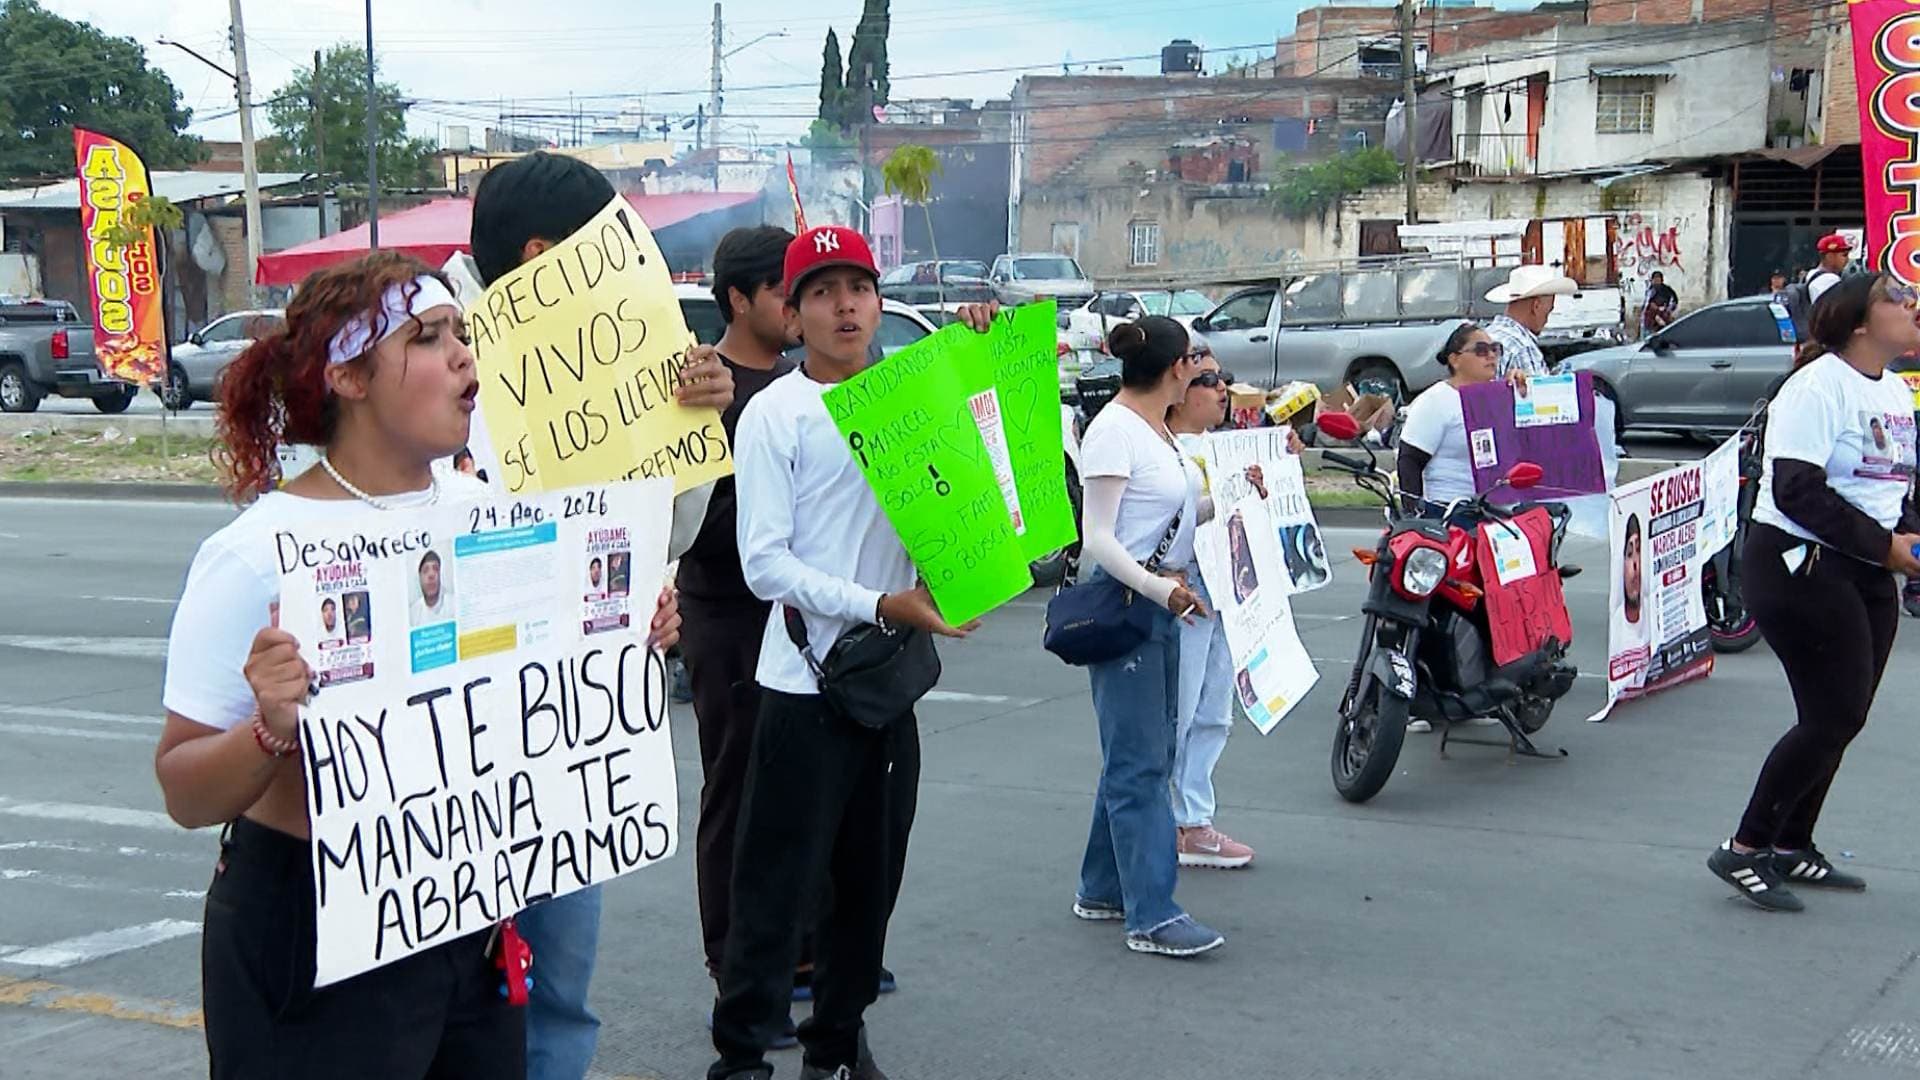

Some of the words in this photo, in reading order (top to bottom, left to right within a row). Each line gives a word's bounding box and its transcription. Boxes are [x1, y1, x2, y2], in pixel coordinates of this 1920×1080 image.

[814, 229, 840, 253] NY
[499, 298, 647, 408] VIVOS
[504, 433, 536, 493] SE
[549, 399, 609, 461] LOS
[1650, 480, 1666, 517] SE
[1666, 467, 1702, 511] BUSCA
[564, 490, 609, 519] 2026
[302, 707, 397, 817] HOY
[406, 676, 496, 789] TE
[518, 643, 667, 759] BUSCO
[317, 771, 542, 907] MAÑANA
[566, 747, 639, 823] TE
[374, 803, 670, 961] ABRAZAMOS
